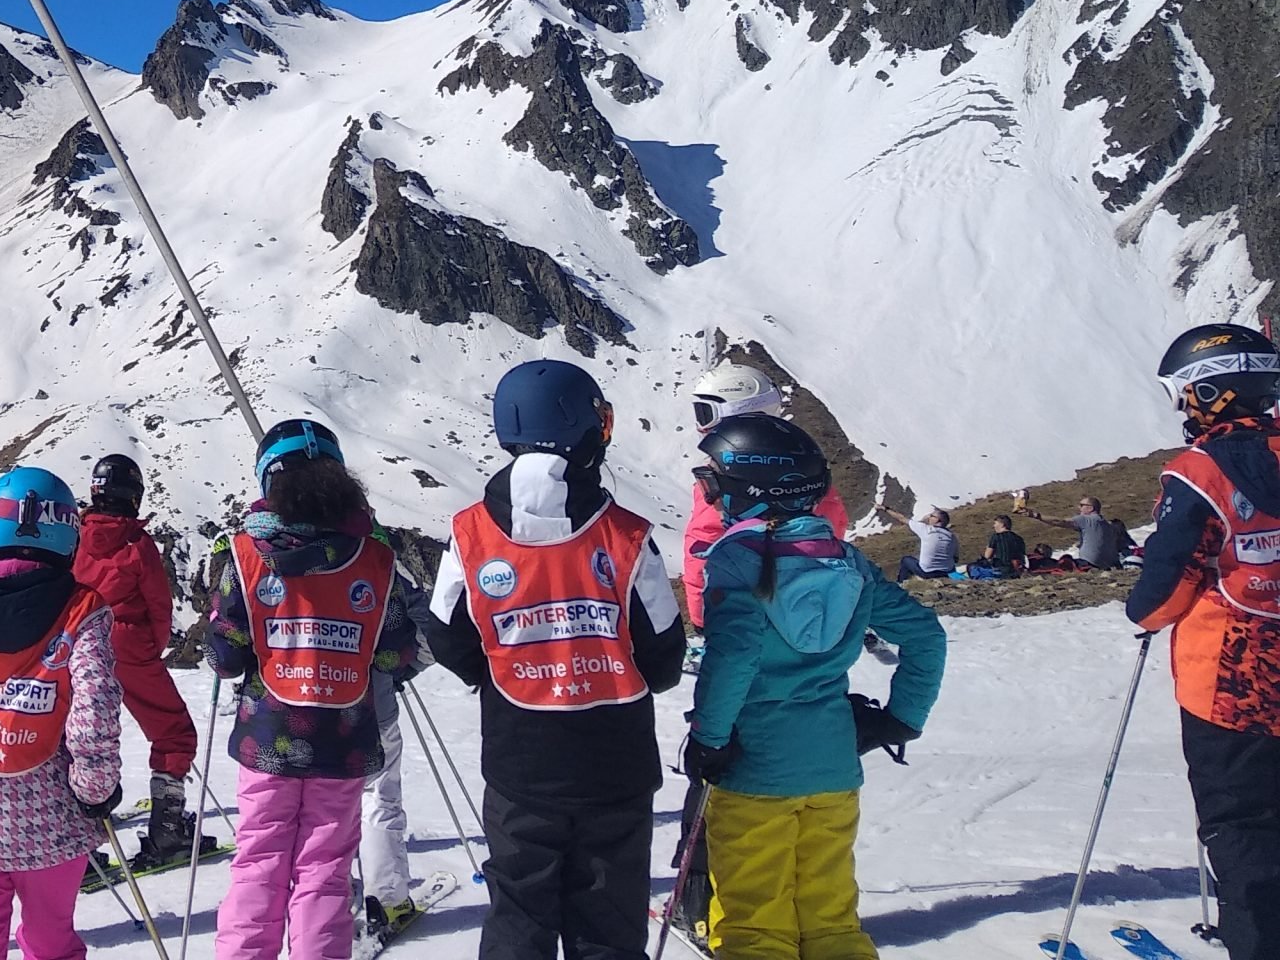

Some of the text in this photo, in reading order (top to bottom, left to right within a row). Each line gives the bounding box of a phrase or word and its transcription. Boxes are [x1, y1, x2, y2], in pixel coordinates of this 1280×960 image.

[482, 571, 513, 587] piau
[258, 585, 282, 597] piau
[280, 622, 359, 640] INTERSPOR
[275, 661, 359, 682] 3ème Étoile
[512, 653, 625, 680] 3ème Étoile
